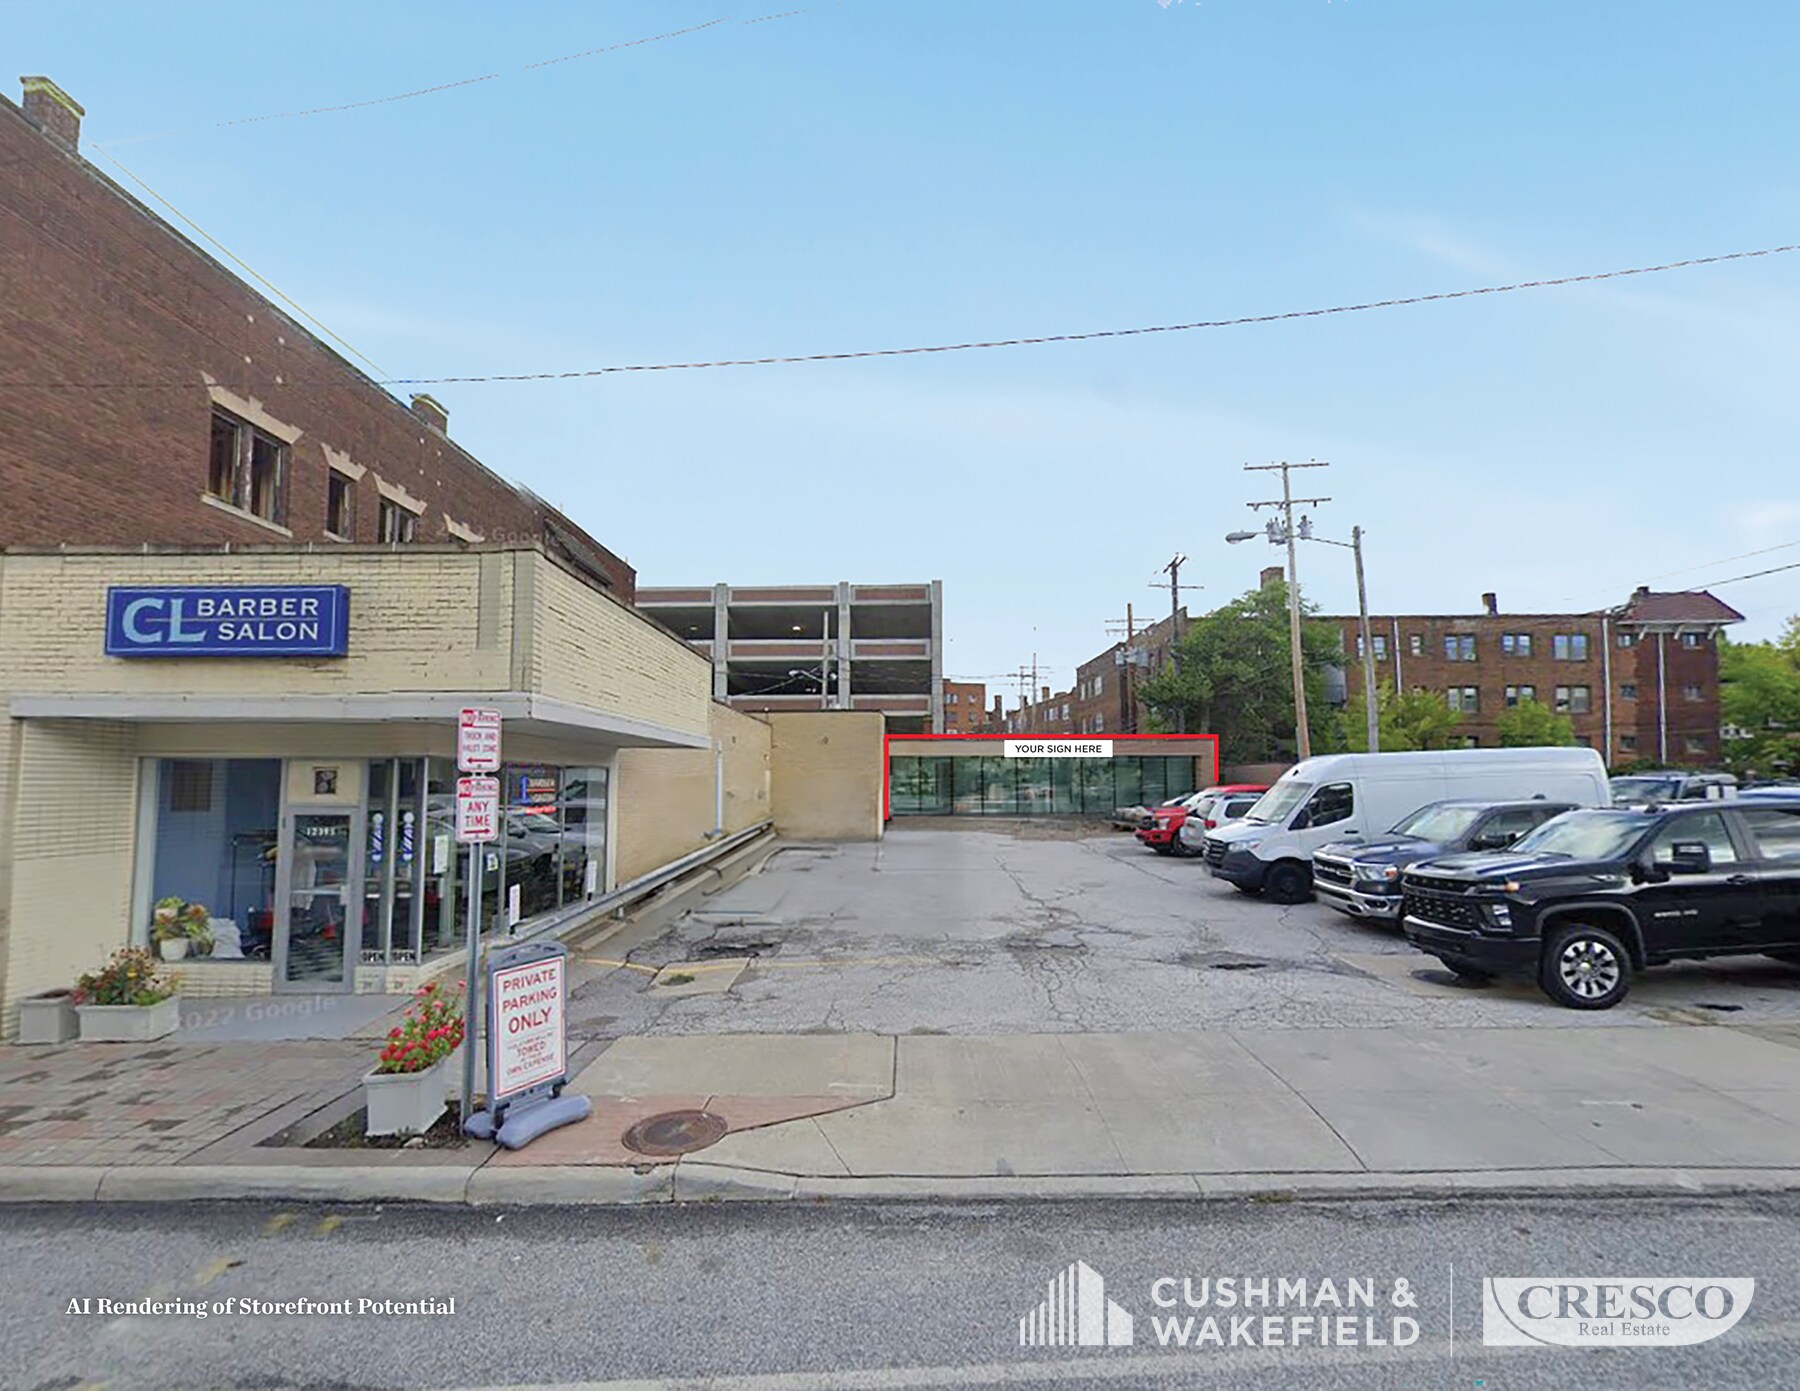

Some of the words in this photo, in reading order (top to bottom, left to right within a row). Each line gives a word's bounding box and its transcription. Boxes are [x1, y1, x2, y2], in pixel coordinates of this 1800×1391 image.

[197, 598, 319, 617] BARBER
[122, 597, 207, 643] CL
[217, 622, 319, 641] SALON
[1015, 745, 1044, 753] YOUR
[1047, 745, 1071, 753] SIGN
[1074, 745, 1102, 753] HERE
[467, 801, 489, 812] ANY
[465, 815, 490, 827] TIME
[363, 951, 384, 962] OPEN
[394, 951, 416, 962] OPEN
[503, 968, 556, 992] PRIVATE
[503, 986, 557, 1012] PARKING
[508, 1006, 552, 1034] ONLY
